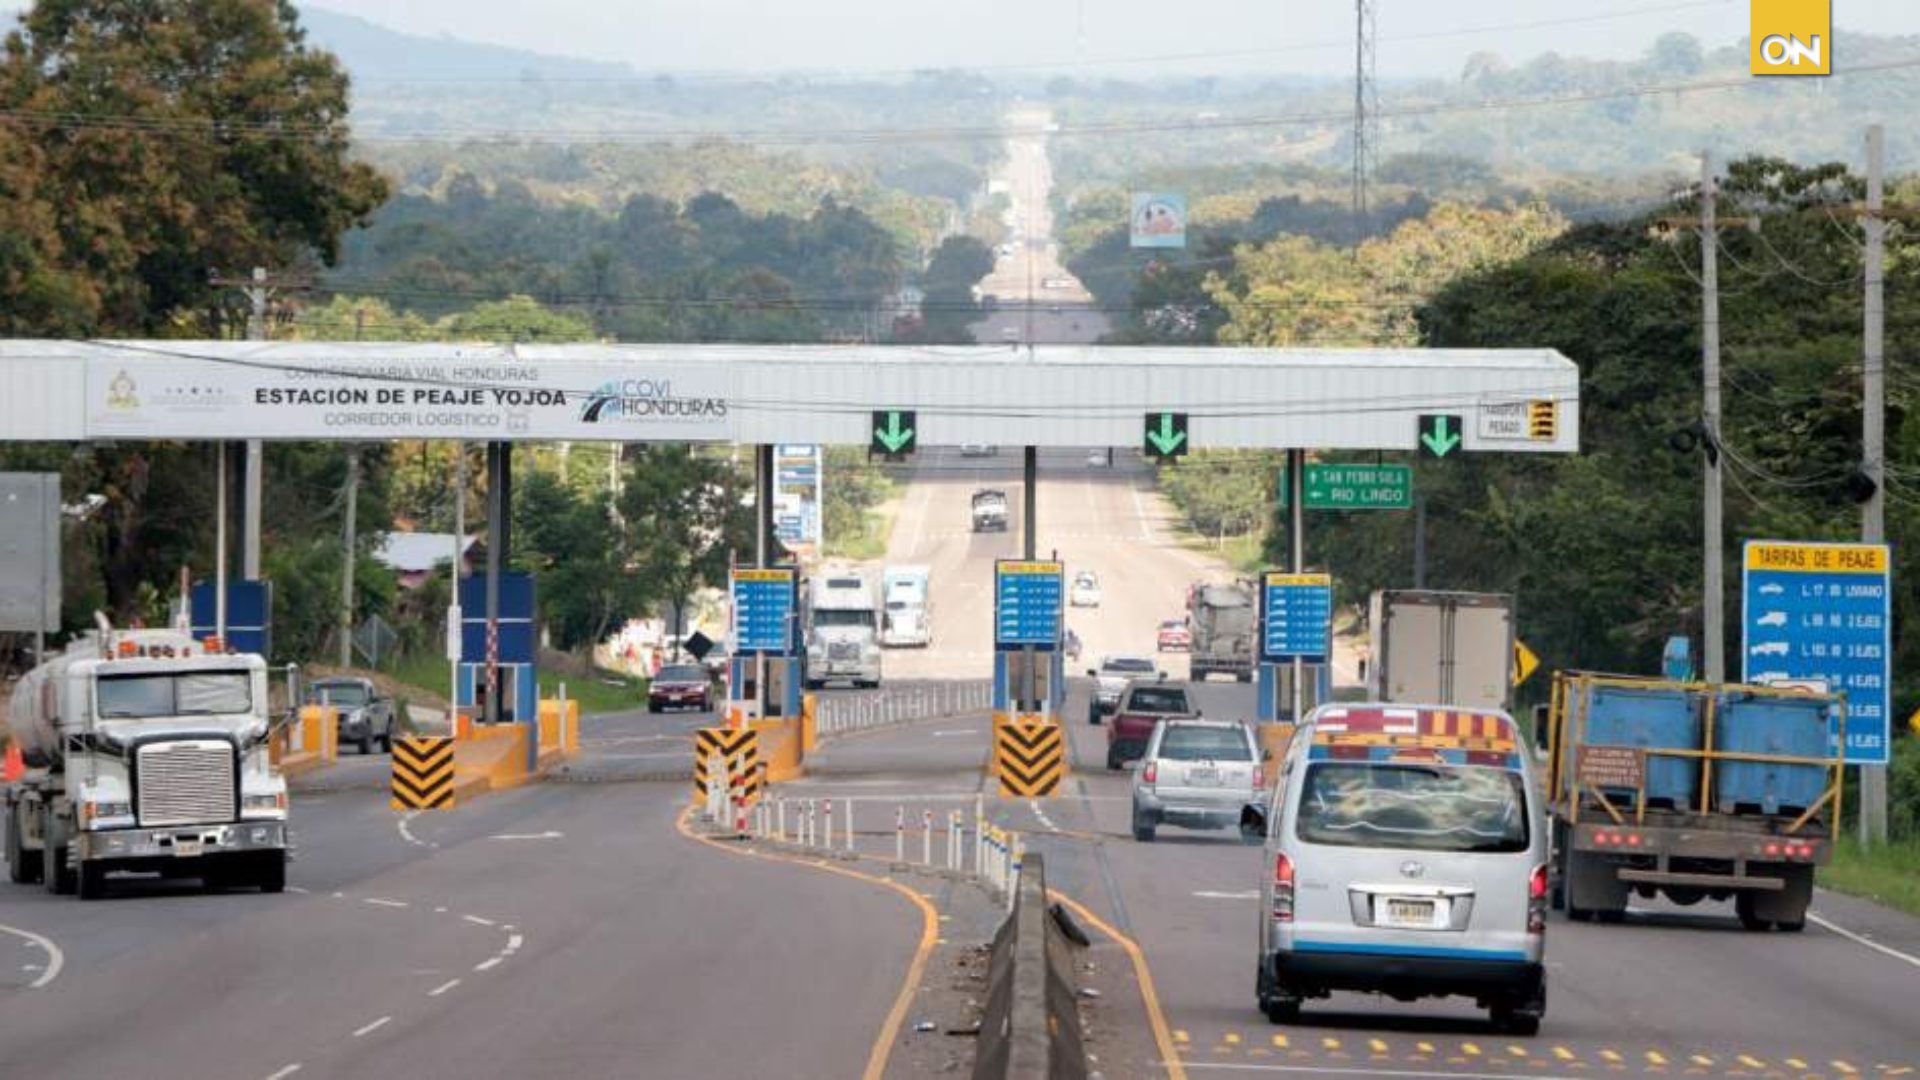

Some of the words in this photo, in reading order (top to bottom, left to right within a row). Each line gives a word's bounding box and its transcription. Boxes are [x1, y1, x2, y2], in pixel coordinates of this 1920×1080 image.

[415, 366, 446, 379] VIAL
[453, 367, 538, 381] HONDURAS
[255, 386, 368, 405] ESTACIÓN
[376, 389, 403, 405] DE
[413, 389, 484, 405] PEAJE
[493, 389, 567, 406] YOJOA
[622, 379, 671, 397] COVI
[621, 398, 728, 416] HONDURAS
[324, 412, 412, 426] CORREDOR
[1361, 488, 1402, 502] LINDO
[1758, 548, 1805, 567] TARIFAS
[1814, 550, 1830, 567] DE
[1839, 550, 1876, 569] PEAJE
